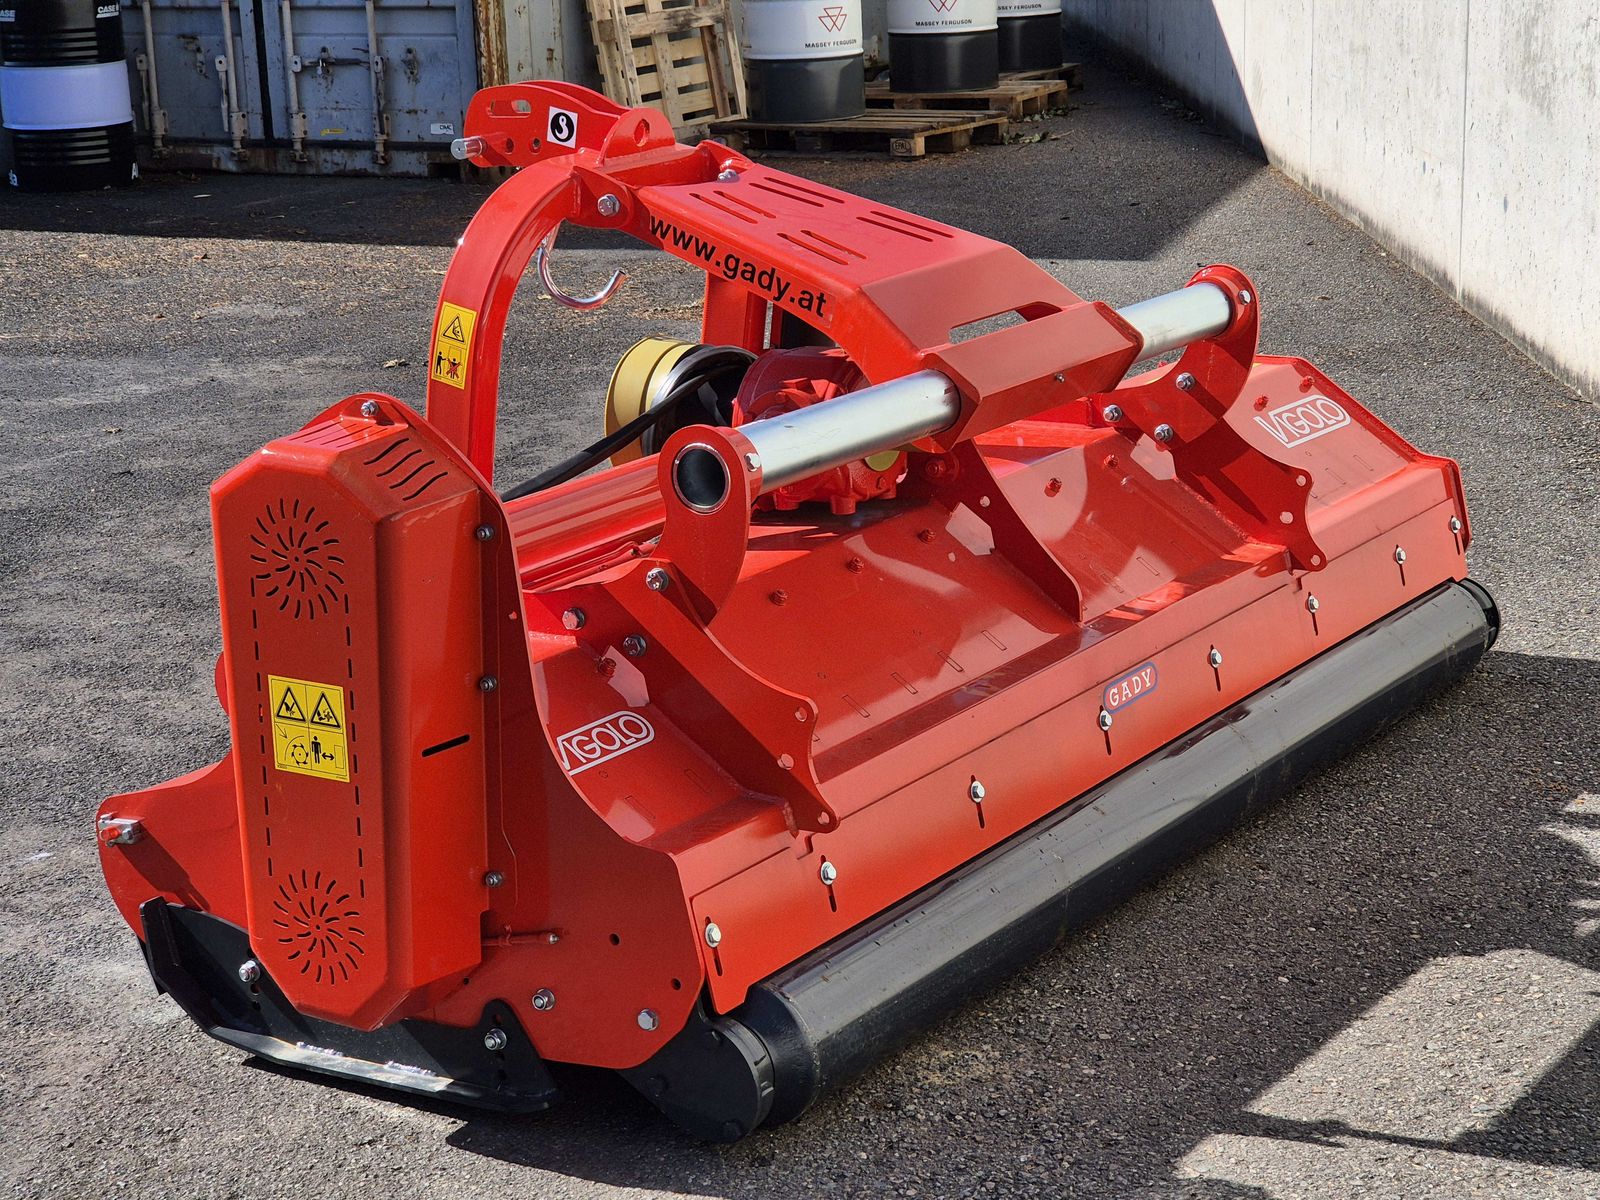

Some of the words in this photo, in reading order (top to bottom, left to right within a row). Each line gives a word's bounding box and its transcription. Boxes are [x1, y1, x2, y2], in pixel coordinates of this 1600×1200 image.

[97, 5, 116, 14] CASE
[941, 18, 973, 26] FERGUSON
[804, 41, 832, 49] MASSEY
[832, 38, 857, 47] FERGUSON
[649, 215, 827, 318] www.gady.at
[1252, 394, 1352, 449] VIGOLO
[1109, 668, 1152, 707] GADY
